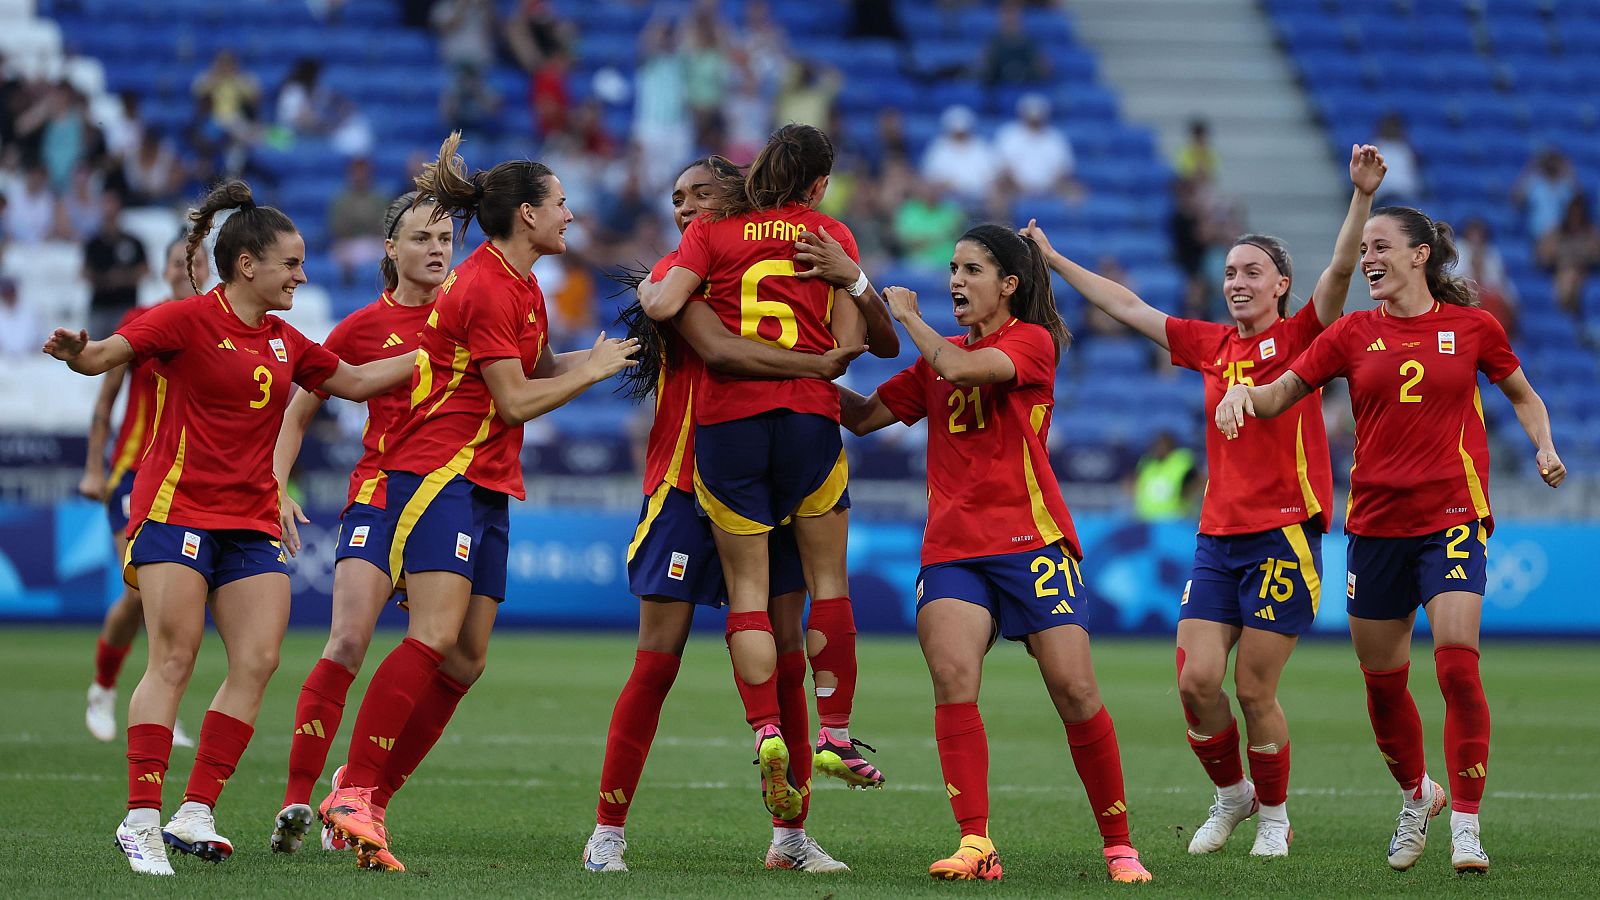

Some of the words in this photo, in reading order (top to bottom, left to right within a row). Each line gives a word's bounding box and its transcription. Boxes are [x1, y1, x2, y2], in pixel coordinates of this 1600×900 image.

[743, 220, 807, 243] AITANA
[741, 259, 799, 350] 6
[249, 365, 273, 409] 3
[1399, 360, 1425, 403] 2
[948, 386, 985, 433] 21
[1445, 524, 1471, 559] 2
[1030, 555, 1076, 598] 21
[1259, 557, 1298, 603] 15
